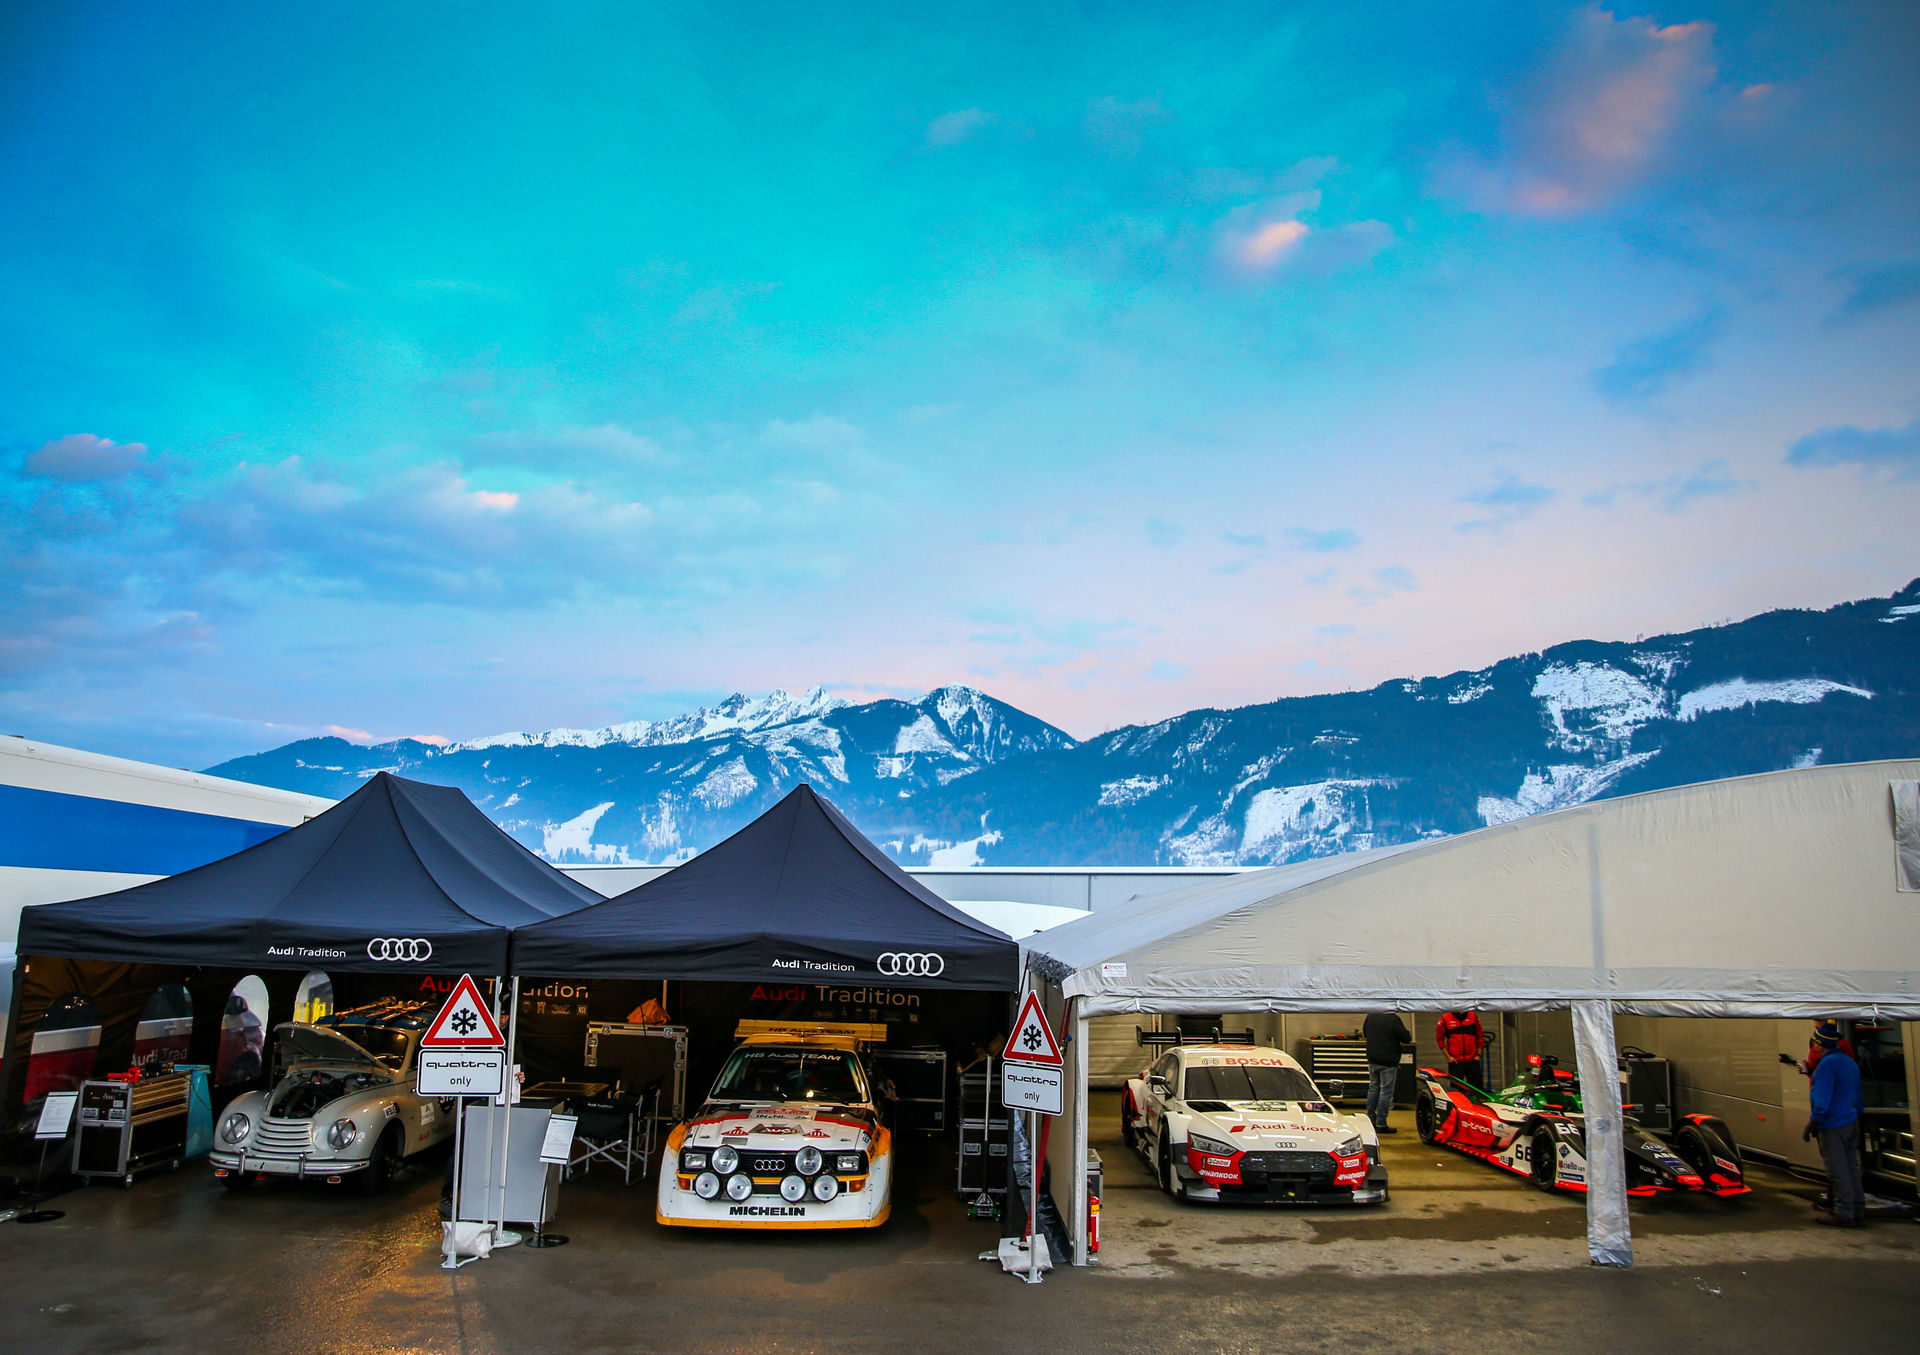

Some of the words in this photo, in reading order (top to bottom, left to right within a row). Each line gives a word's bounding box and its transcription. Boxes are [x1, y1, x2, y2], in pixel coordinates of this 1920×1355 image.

[267, 946, 294, 955] Audi
[298, 947, 347, 957] Tradition
[772, 958, 800, 968] Audi
[804, 960, 855, 971] Tradition
[750, 984, 806, 1001] Audi
[815, 985, 920, 1007] Tradition
[802, 1053, 841, 1061] TEAM
[1225, 1058, 1283, 1066] BOSCH
[426, 1061, 497, 1069] quattro
[450, 1076, 471, 1086] only
[1007, 1074, 1058, 1086] quattro
[1024, 1091, 1040, 1103] only
[1251, 1123, 1286, 1131] Audi
[1290, 1123, 1335, 1134] Sport
[1461, 1120, 1492, 1134] e-tron
[1554, 1122, 1580, 1136] 66
[729, 1206, 806, 1216] MICHELIN
